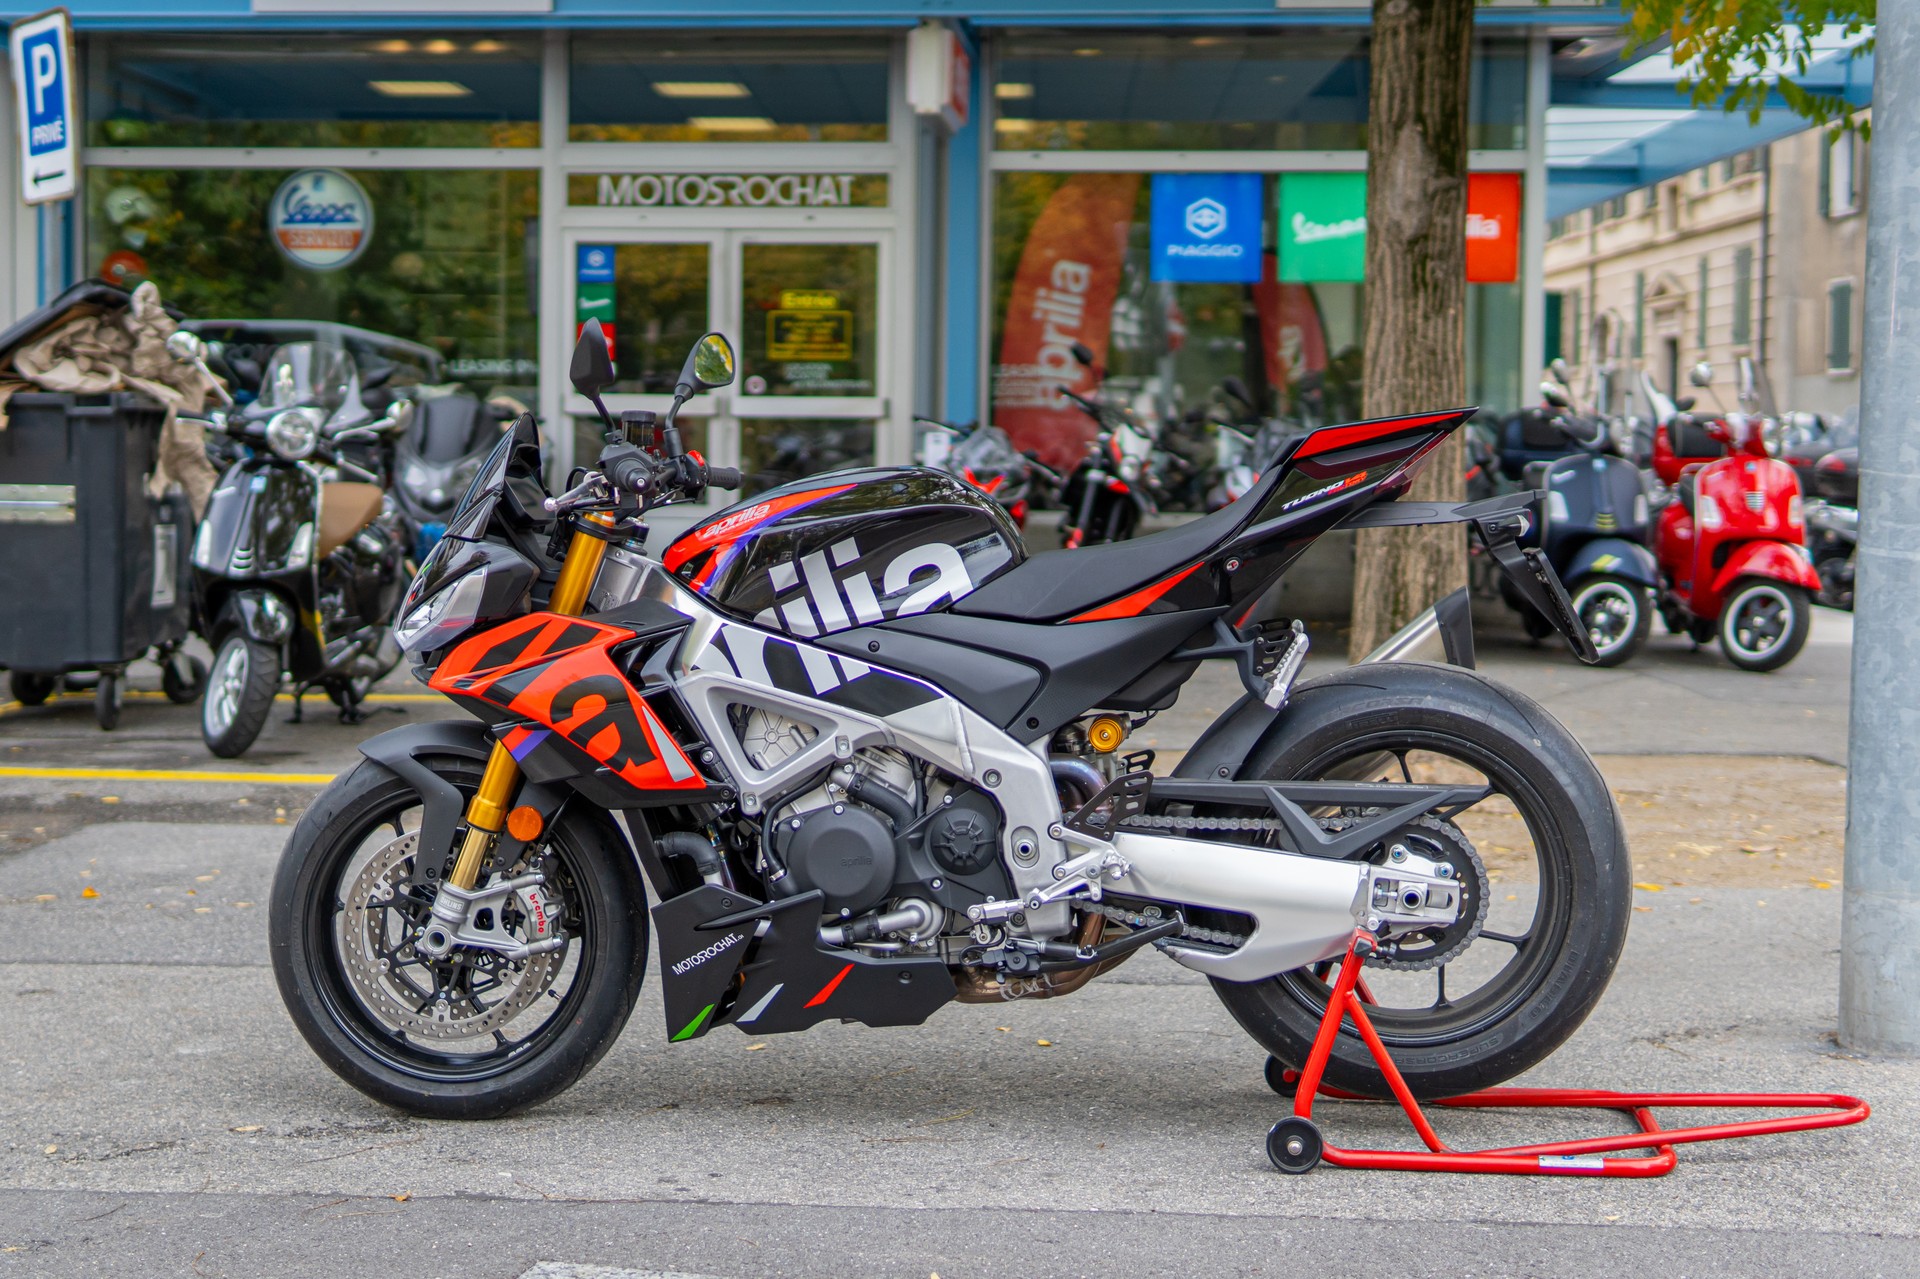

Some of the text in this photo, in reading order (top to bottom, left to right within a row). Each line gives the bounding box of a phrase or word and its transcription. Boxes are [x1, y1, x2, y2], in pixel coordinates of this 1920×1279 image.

[31, 42, 57, 115] P
[1167, 244, 1244, 257] PIAGGIO
[1033, 259, 1092, 410] aprilia
[1281, 480, 1345, 511] TUONO
[703, 504, 771, 539] aprilia
[840, 855, 873, 869] aprilia
[529, 893, 547, 934] brembo
